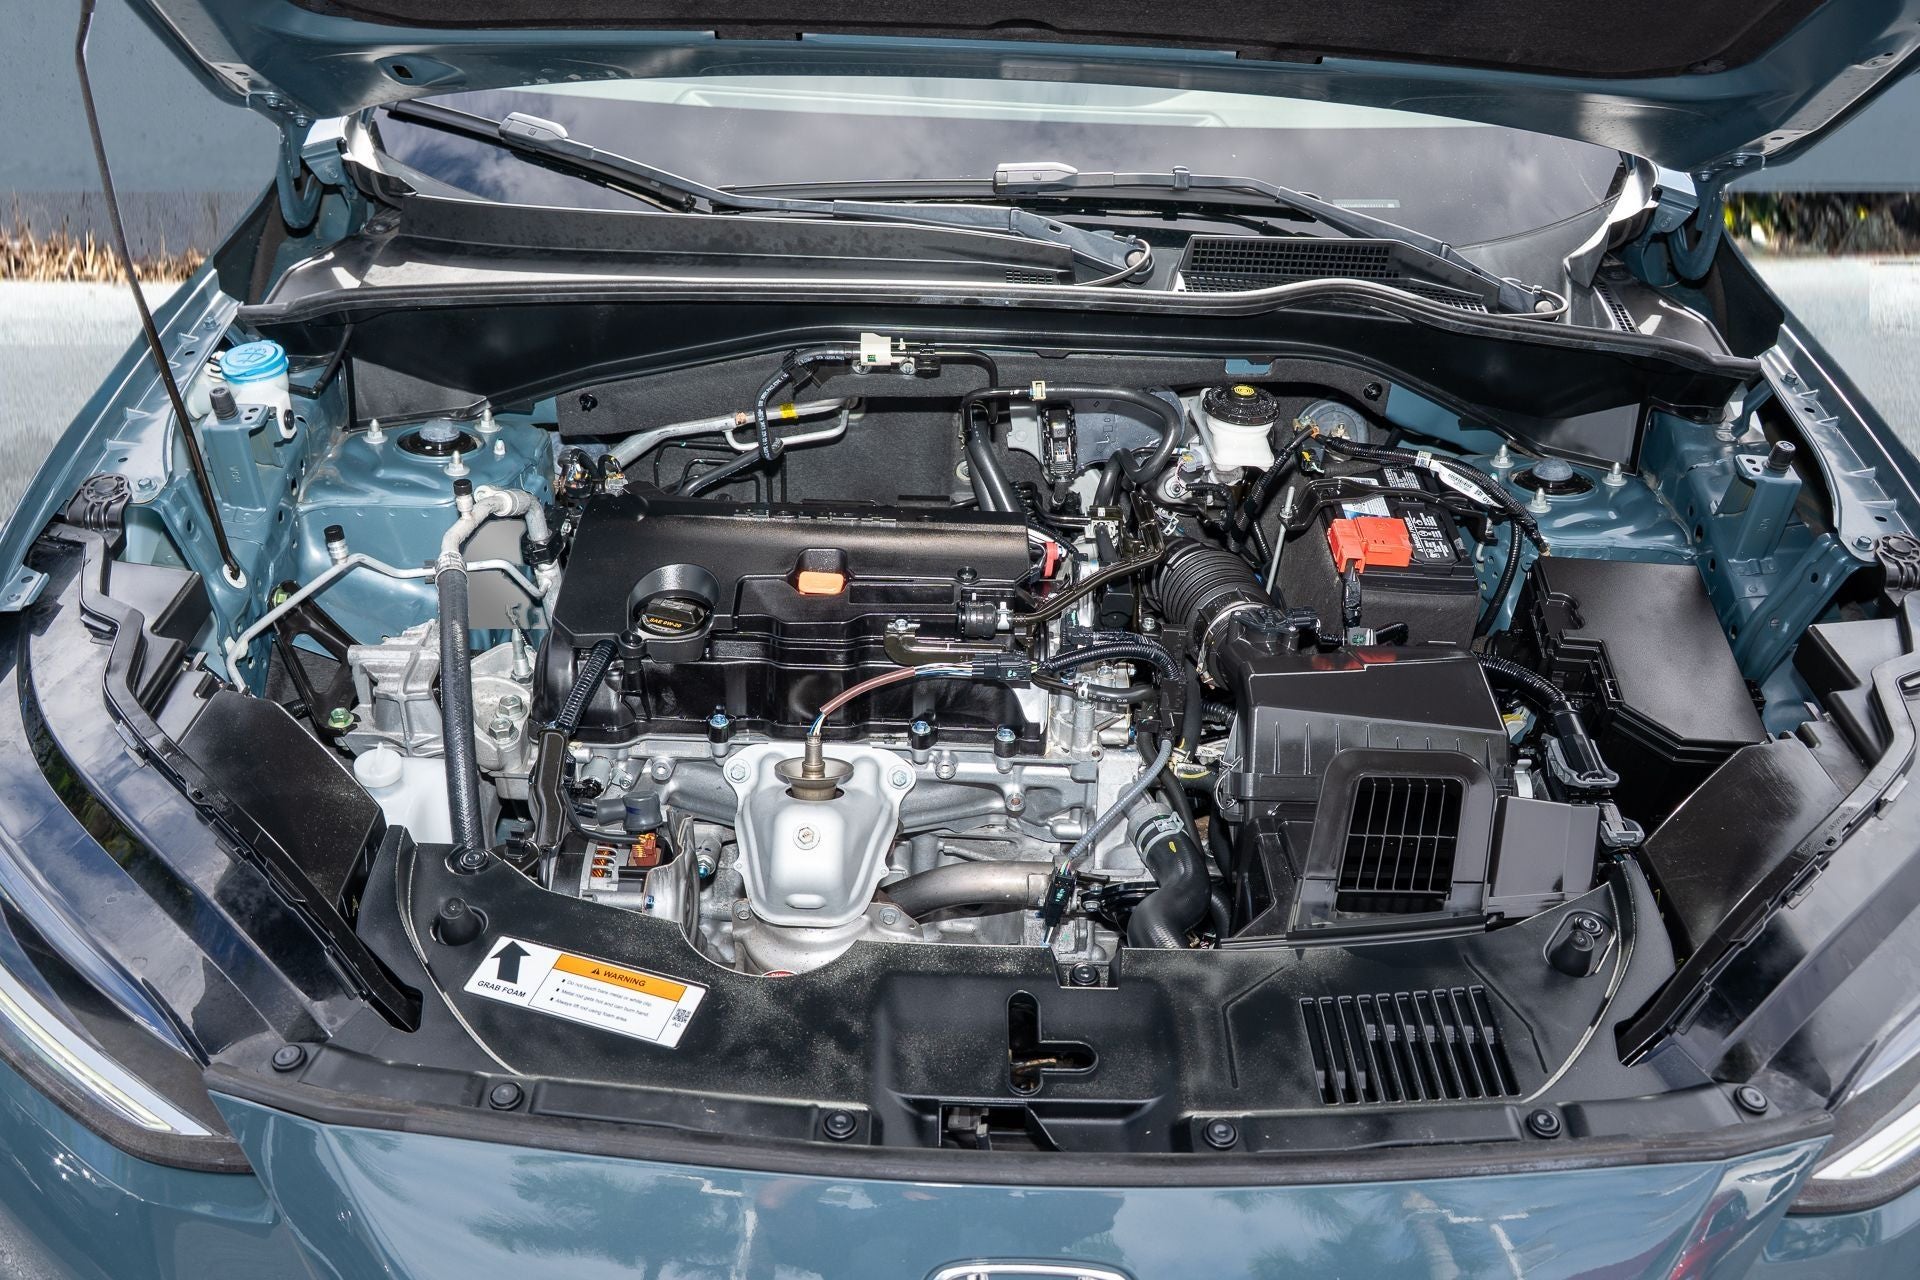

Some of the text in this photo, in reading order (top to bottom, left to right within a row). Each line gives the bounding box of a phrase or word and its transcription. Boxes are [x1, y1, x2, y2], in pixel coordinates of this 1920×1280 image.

[603, 970, 646, 987] WARNING
[477, 980, 527, 998] GRAB FOAM
